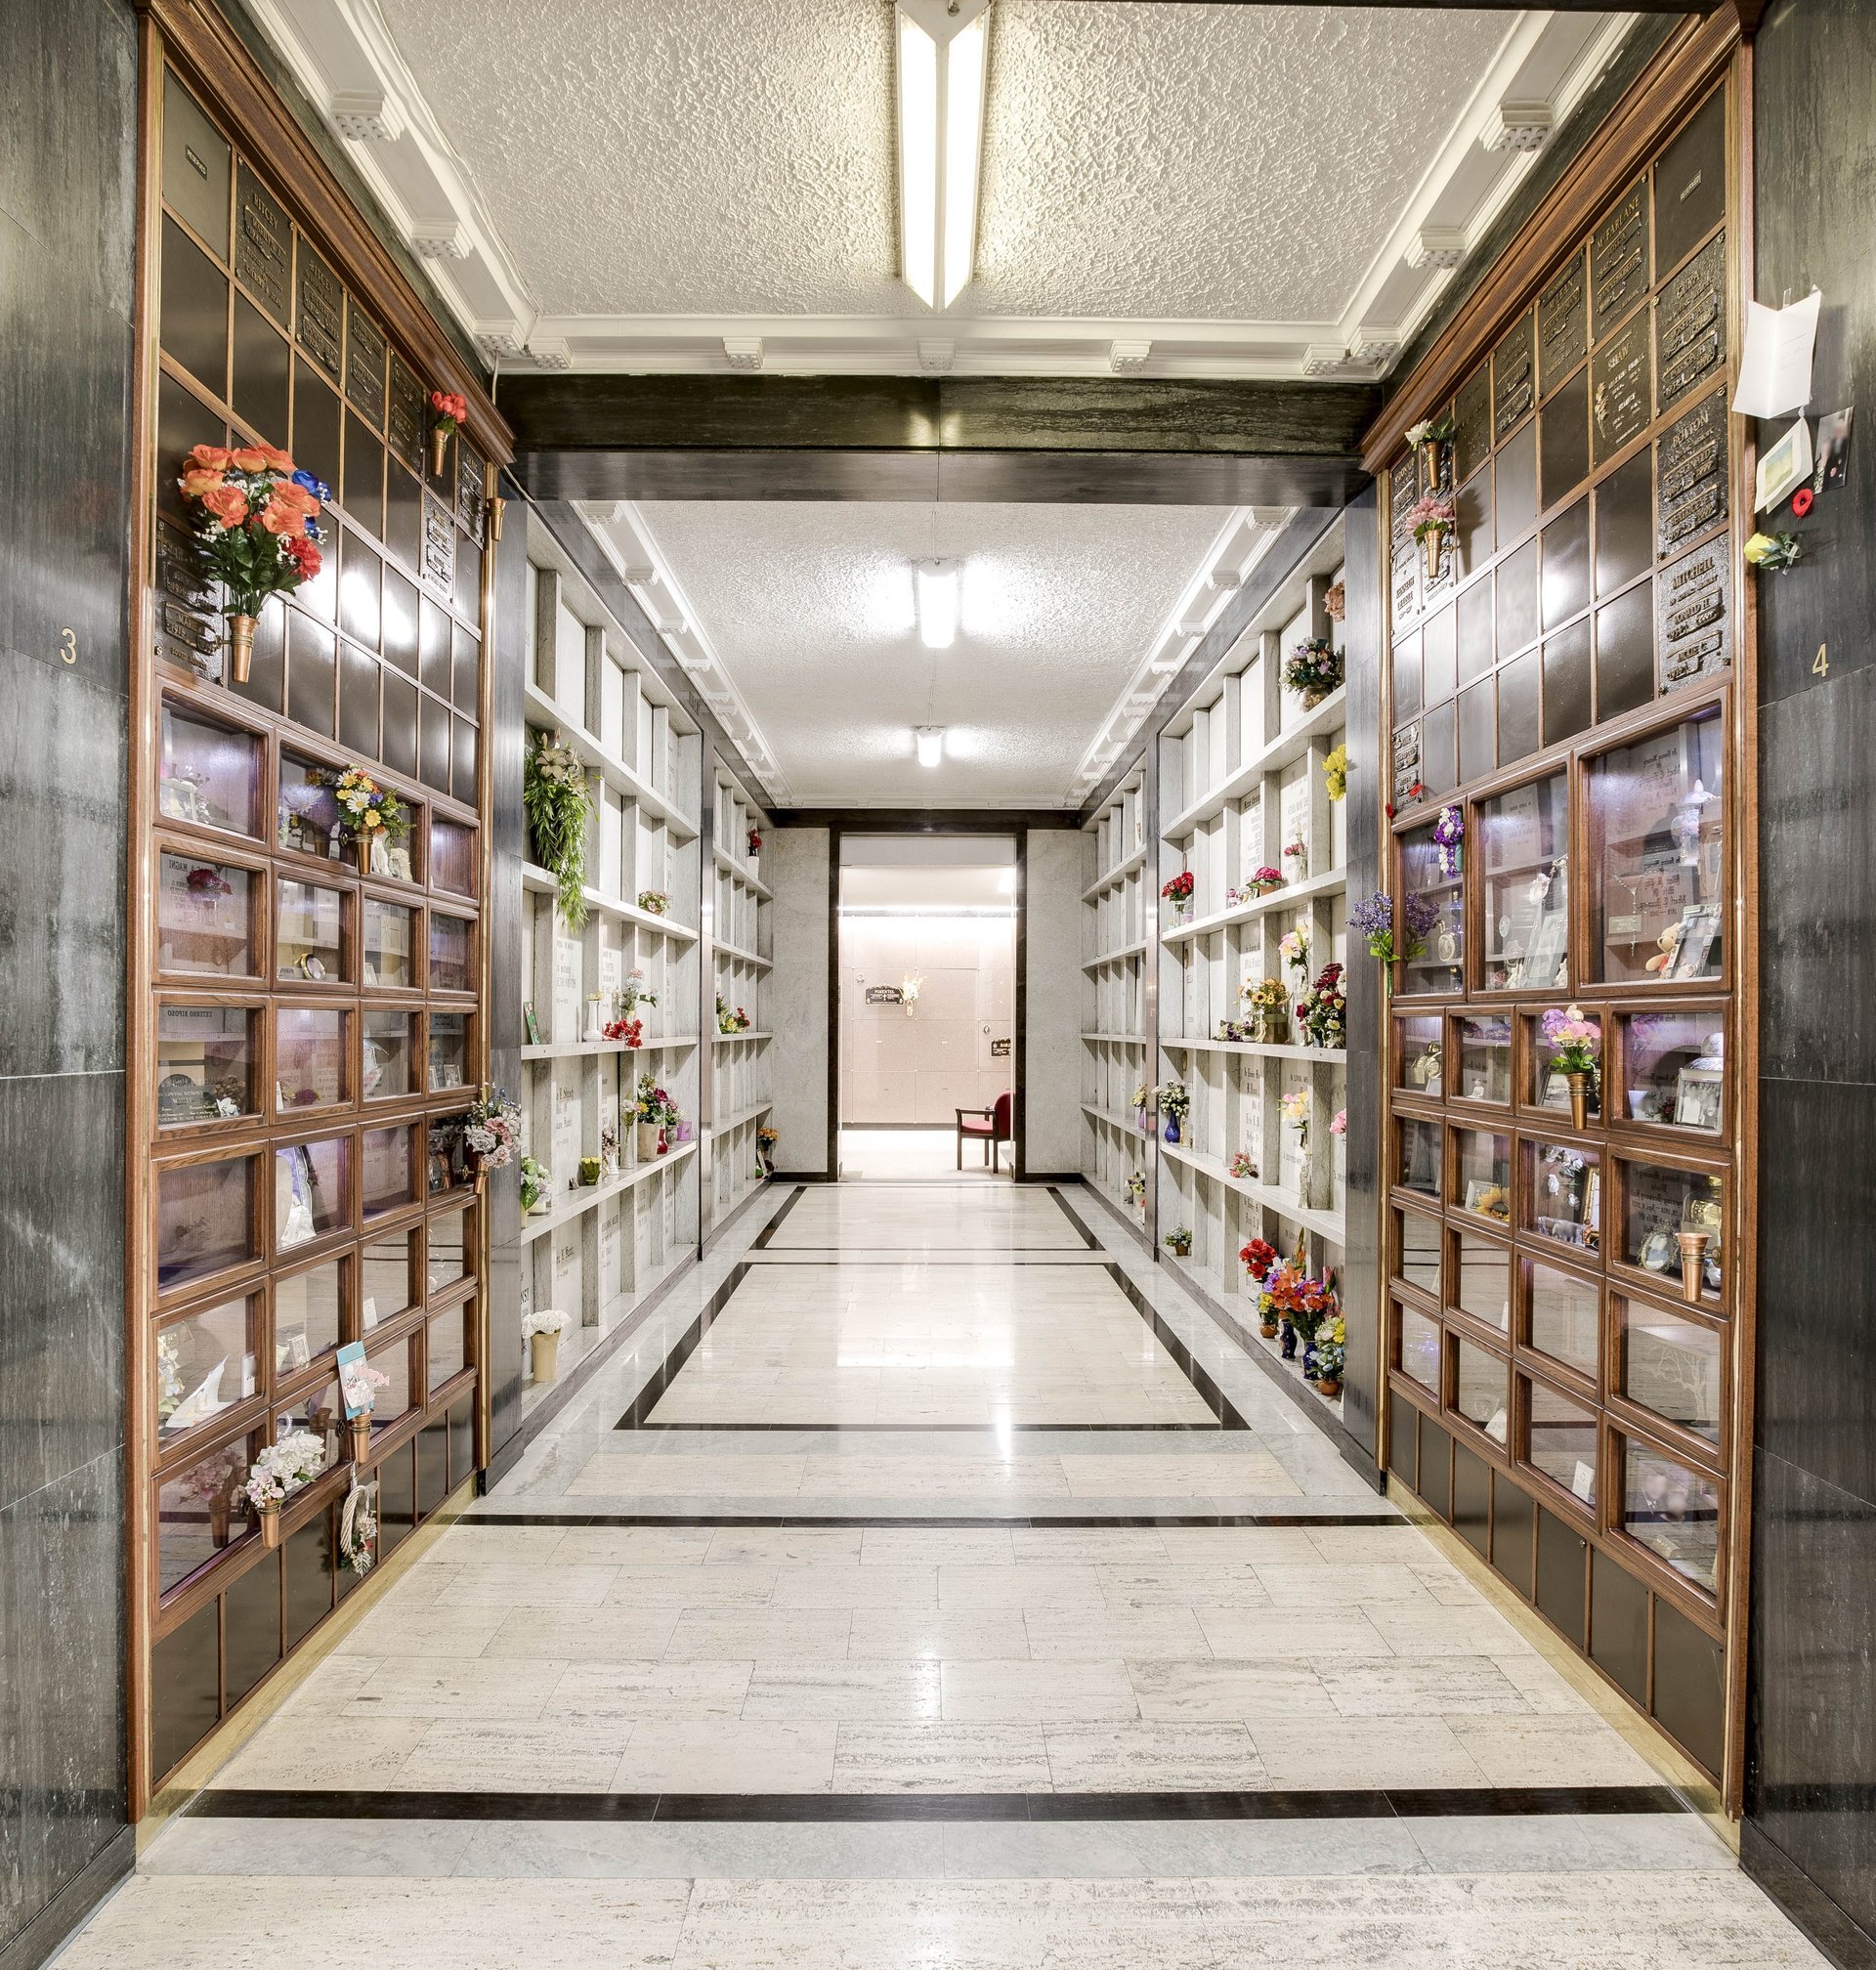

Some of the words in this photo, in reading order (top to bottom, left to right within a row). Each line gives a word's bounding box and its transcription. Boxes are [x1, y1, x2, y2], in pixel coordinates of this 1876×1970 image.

[187, 149, 206, 175] RESERVED
[253, 193, 279, 230] RITCEY
[1672, 556, 1716, 590] MITCHELL
[61, 626, 77, 665] 3
[1812, 642, 1829, 678] 4
